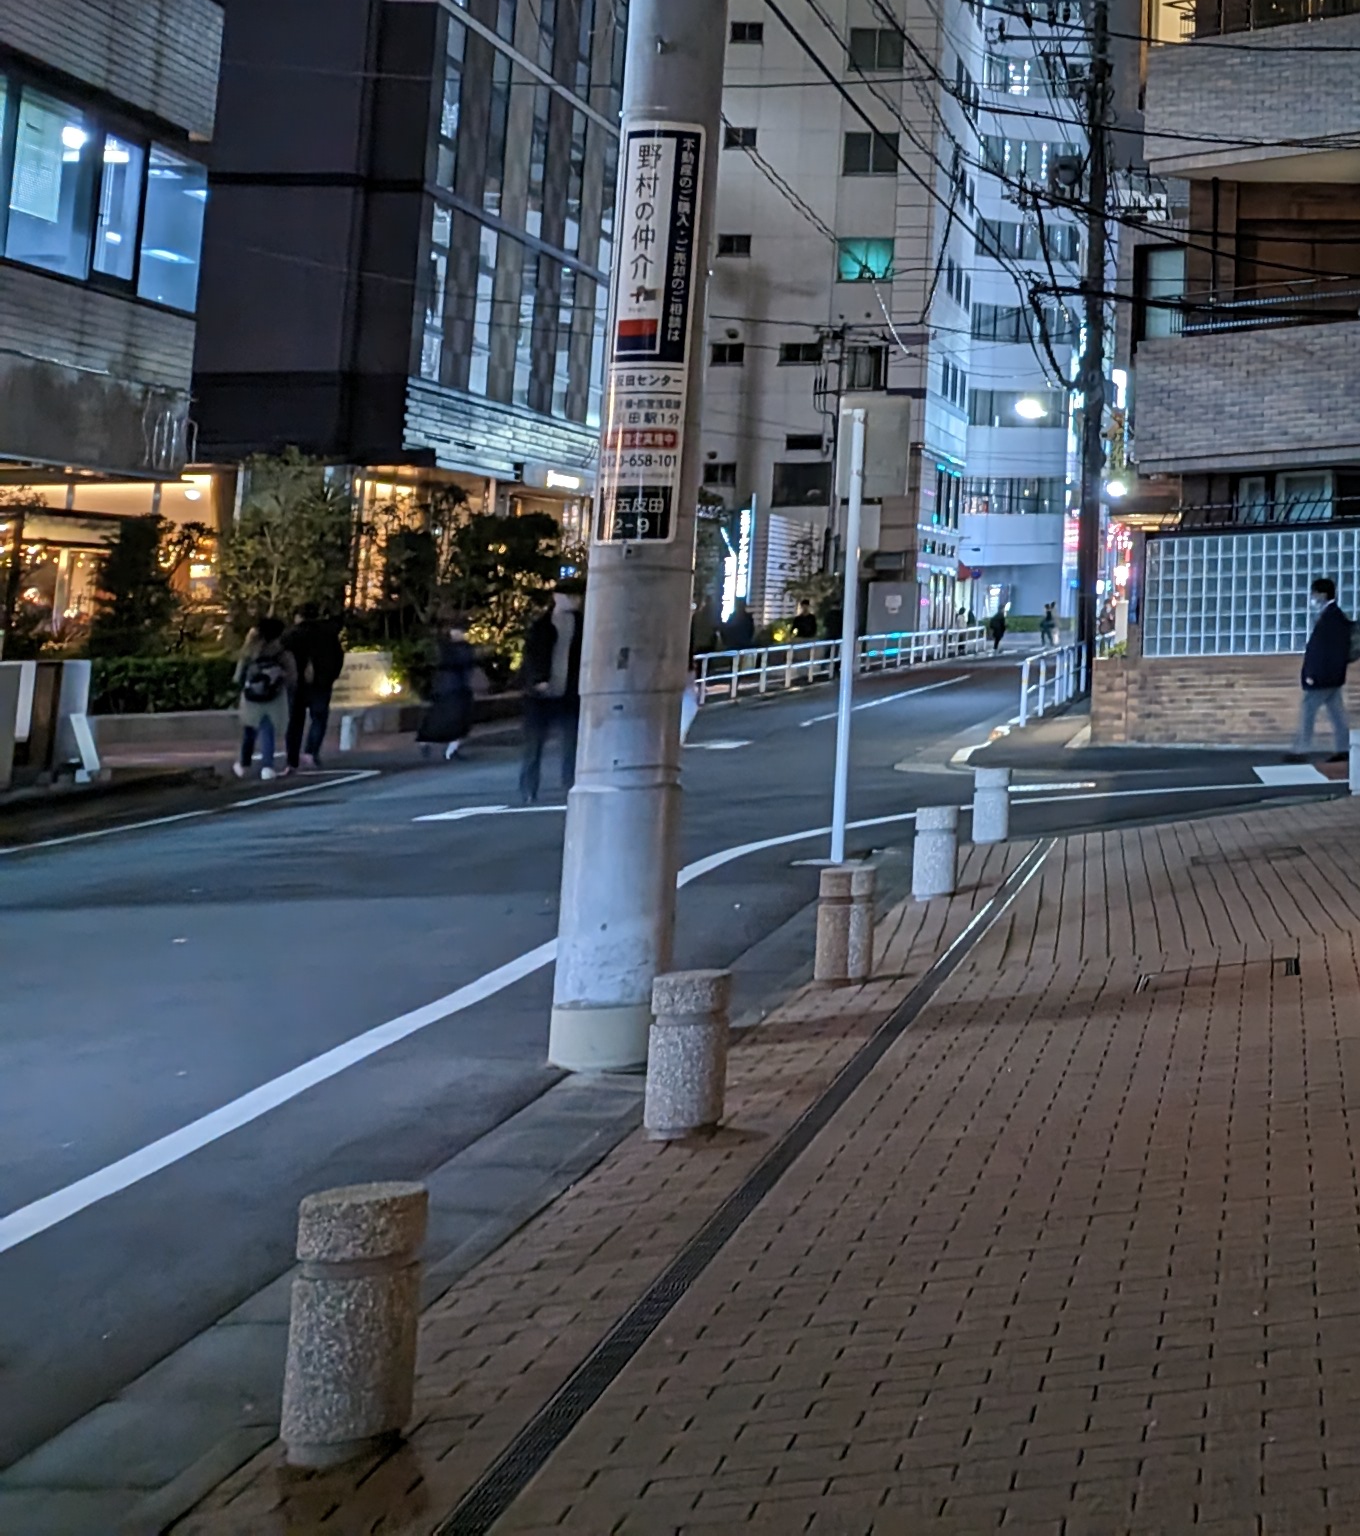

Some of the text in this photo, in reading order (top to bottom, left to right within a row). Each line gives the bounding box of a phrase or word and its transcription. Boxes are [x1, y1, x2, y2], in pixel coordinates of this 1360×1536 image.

[631, 144, 662, 280] 野村の仲介
[608, 374, 682, 387] 反田センター
[604, 497, 664, 514] 五反田
